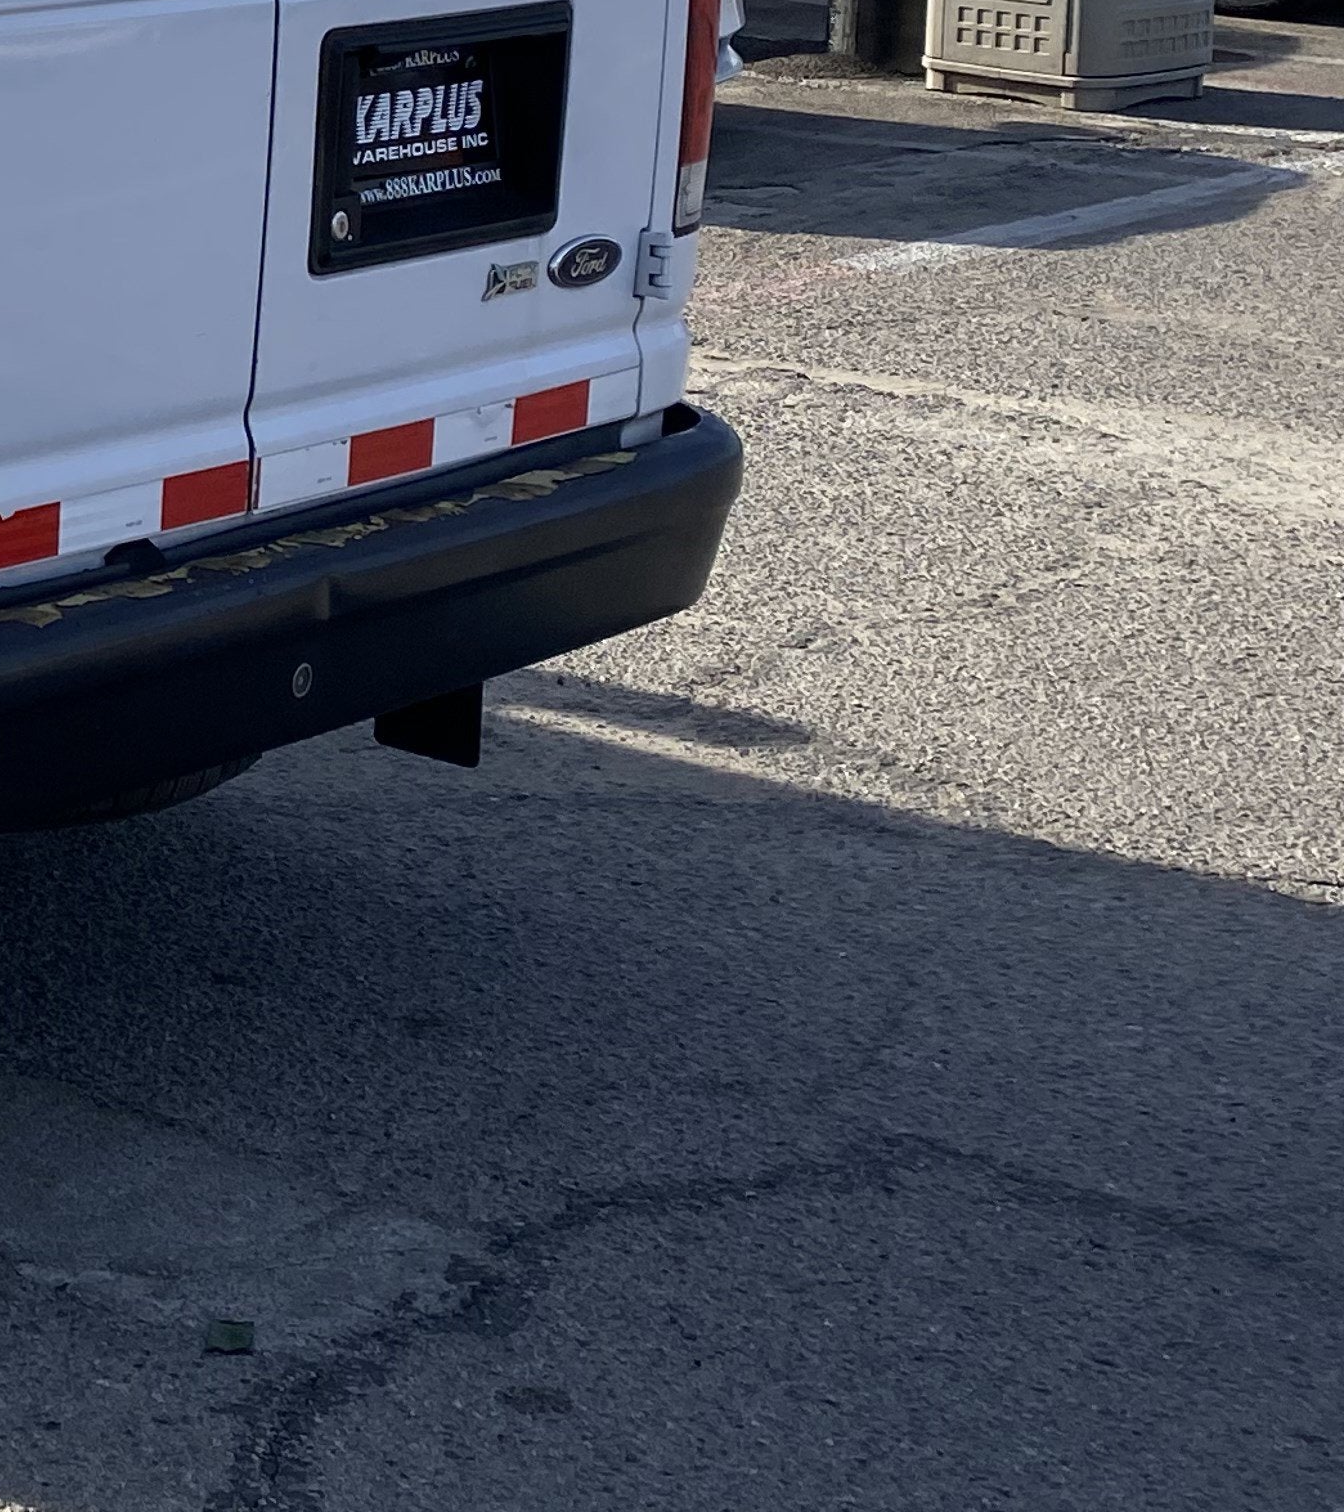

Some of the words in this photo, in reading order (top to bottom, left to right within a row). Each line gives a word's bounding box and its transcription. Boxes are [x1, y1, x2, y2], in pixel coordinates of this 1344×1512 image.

[356, 79, 483, 144] KARPLUS
[462, 132, 489, 149] INC
[571, 247, 608, 277] Ford
